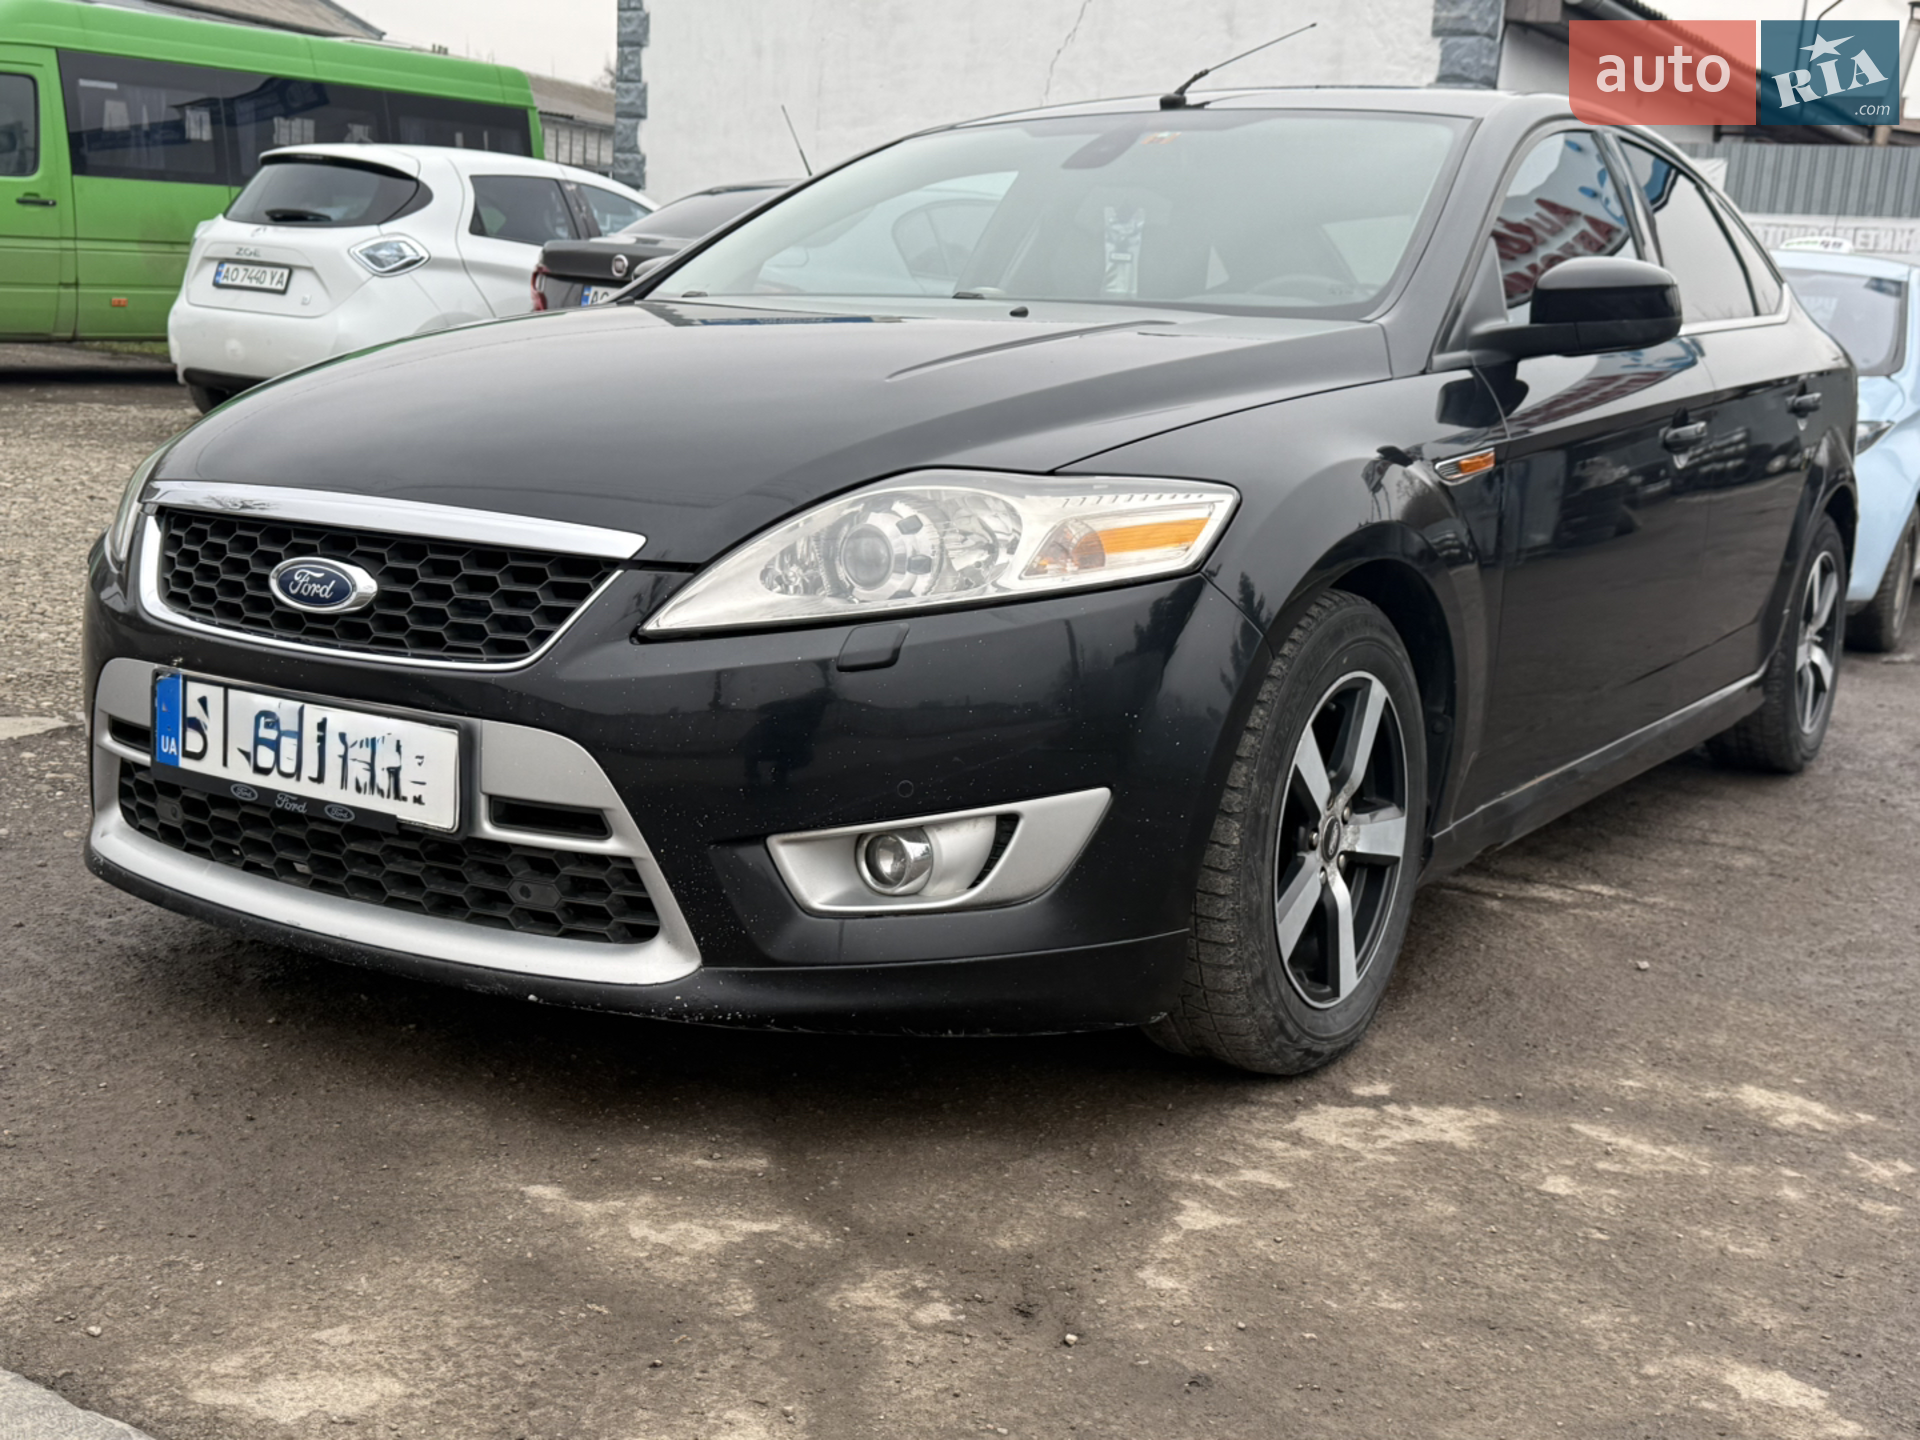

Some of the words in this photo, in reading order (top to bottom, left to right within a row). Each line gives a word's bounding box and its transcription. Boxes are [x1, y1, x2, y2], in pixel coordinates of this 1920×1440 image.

[236, 247, 261, 257] ZOE
[222, 266, 240, 282] AO
[241, 267, 267, 285] 7440
[289, 569, 336, 599] Ford
[161, 734, 178, 756] UA
[275, 792, 308, 814] Ford
